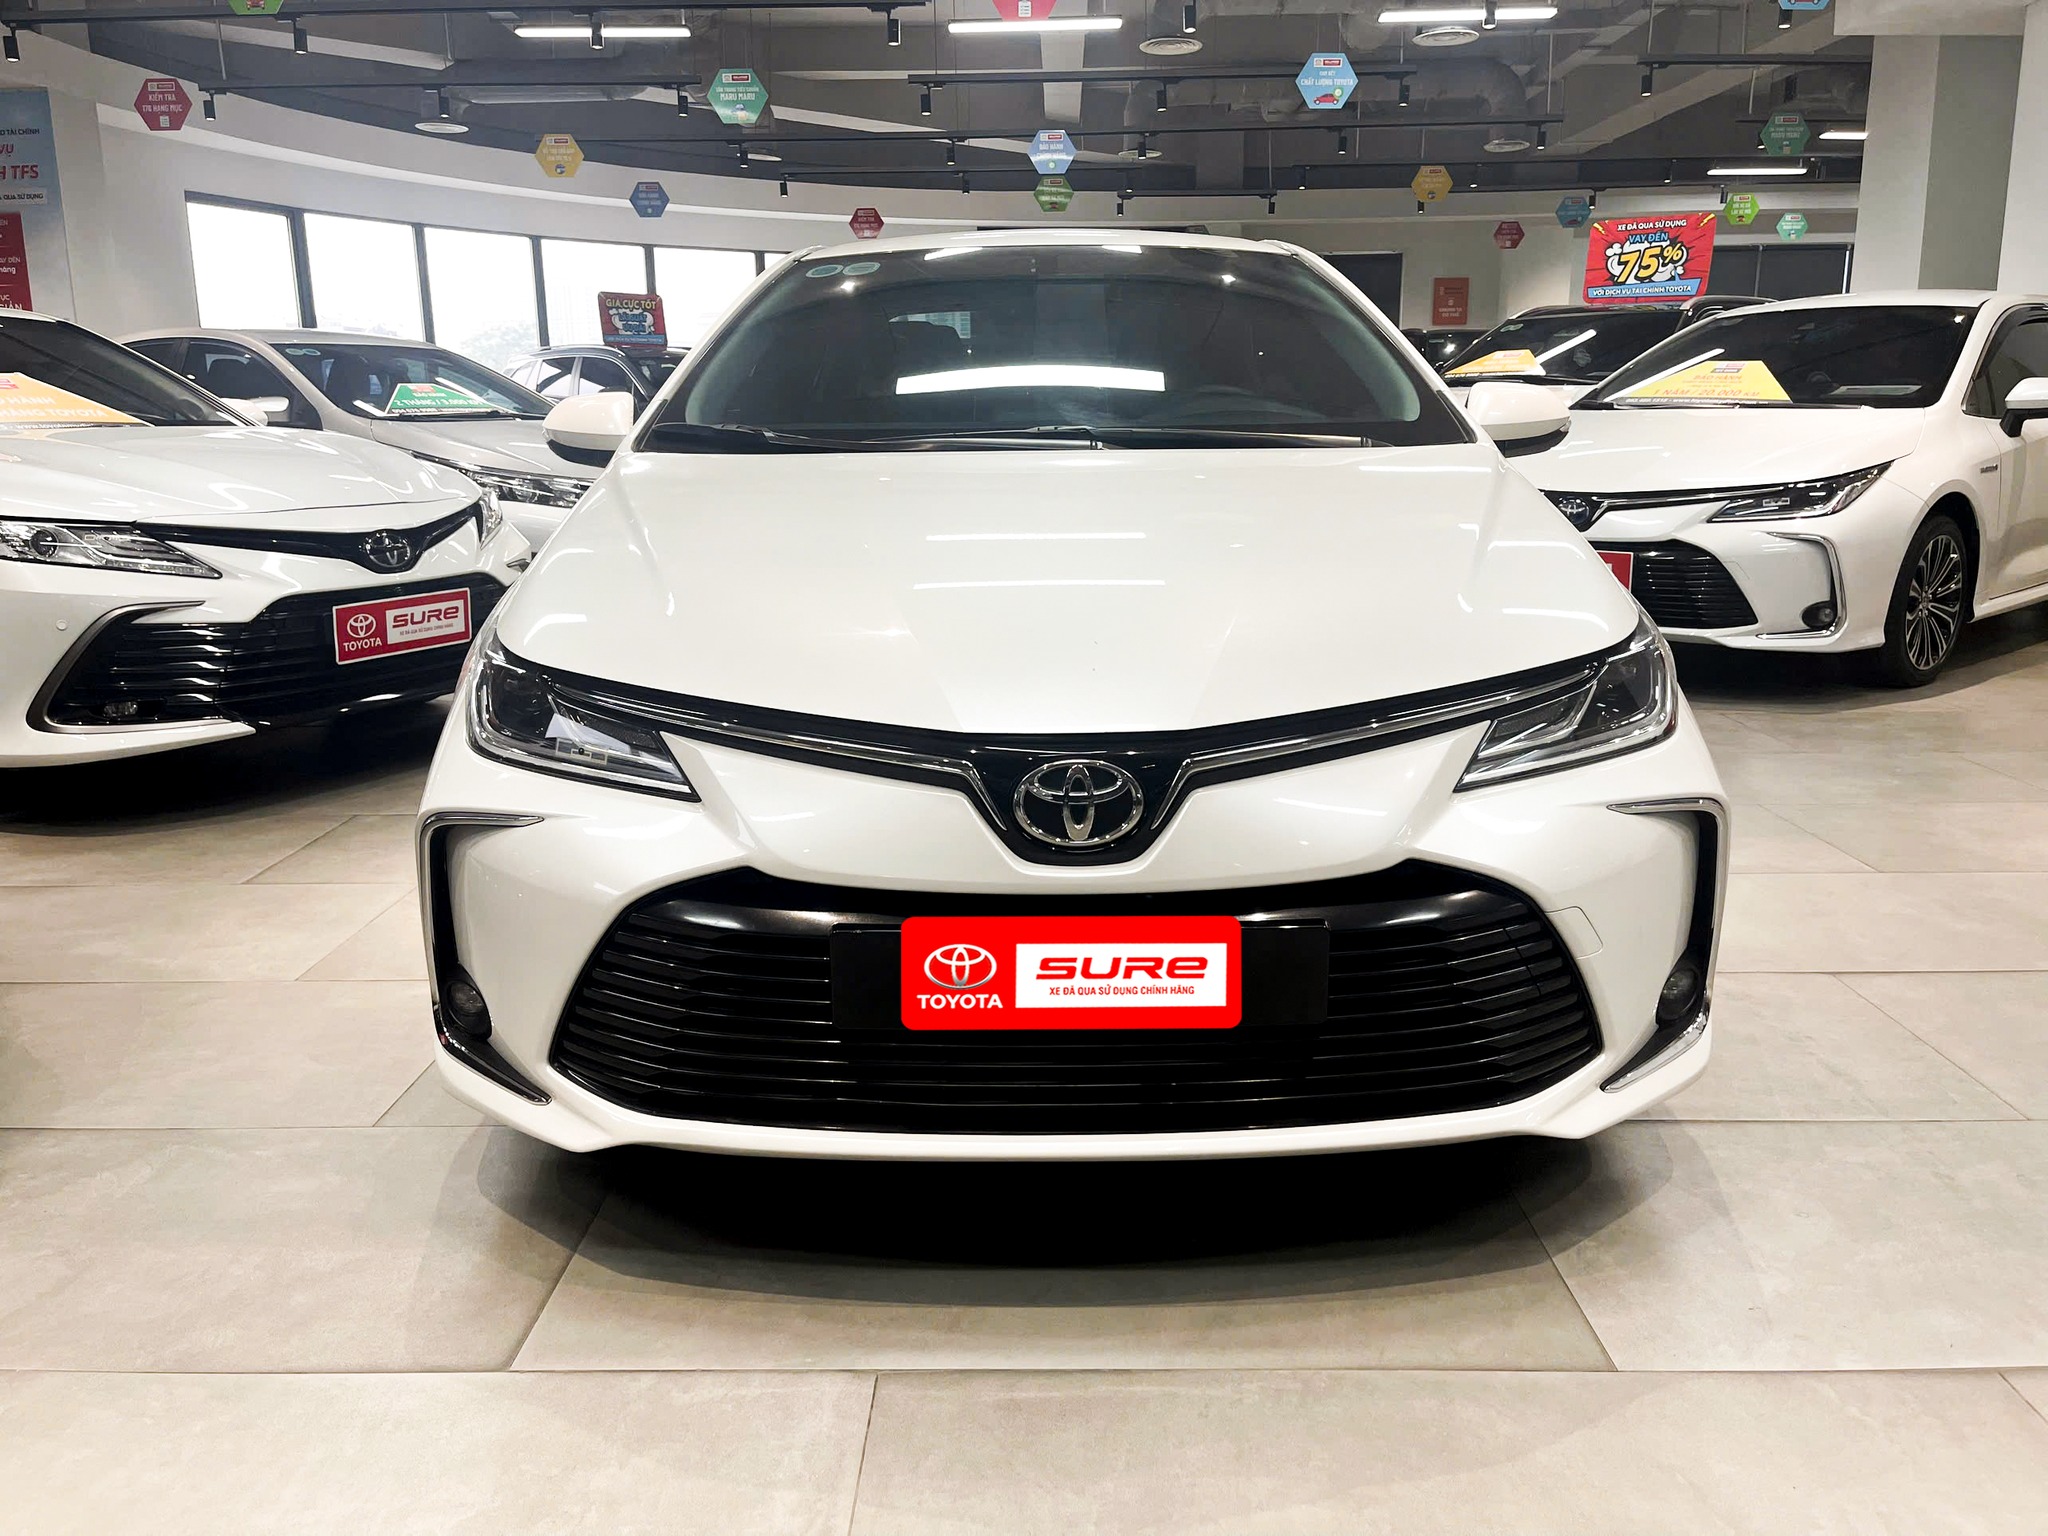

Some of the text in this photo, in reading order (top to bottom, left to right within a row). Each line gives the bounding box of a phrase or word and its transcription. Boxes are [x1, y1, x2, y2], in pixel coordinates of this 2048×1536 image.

[164, 93, 176, 101] TRA
[720, 93, 755, 101] MARU MARU
[10, 164, 39, 180] TFS
[1665, 219, 1687, 228] DỤNG
[1629, 231, 1669, 243] VAY ĐẾN
[1617, 243, 1683, 283] 75%
[1605, 288, 1620, 296] DỊCH
[640, 298, 656, 309] TỐT
[45, 408, 108, 417] TOYOTA
[343, 637, 382, 652] TOYOTA
[1049, 986, 1061, 996] XE
[1063, 985, 1075, 996] ĐÃ
[1077, 986, 1097, 996] QUA
[1098, 983, 1112, 996] SỬ
[1113, 986, 1138, 997] DỤNG
[1140, 984, 1168, 995] CHÍNH
[916, 993, 1003, 1009] TOYOTA
